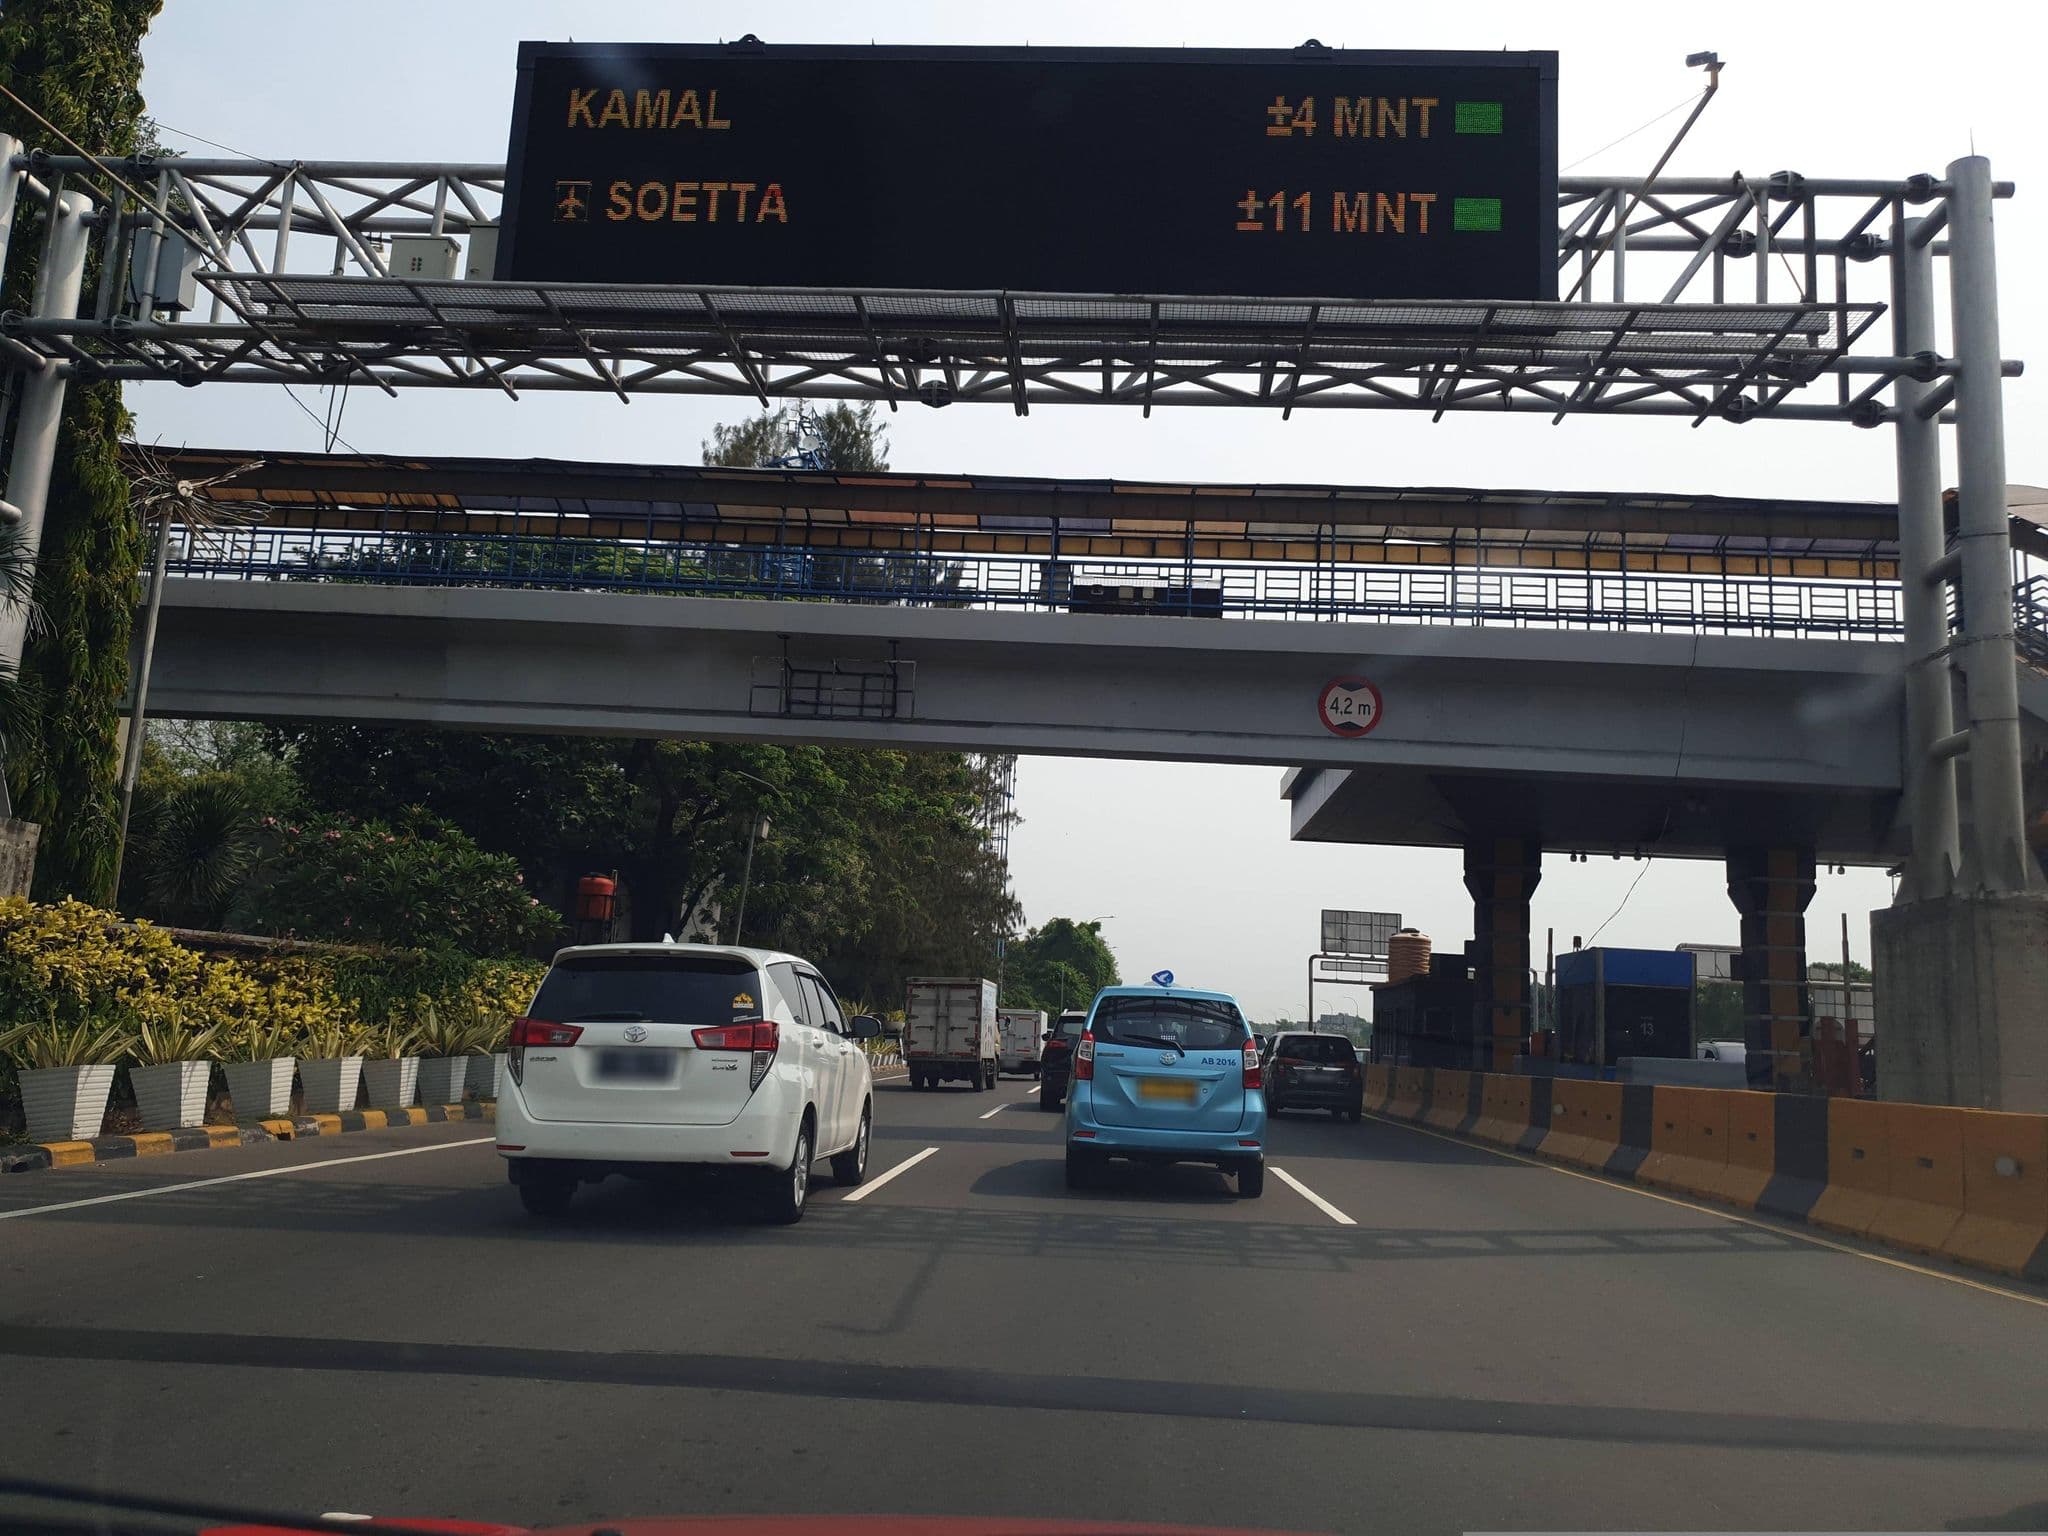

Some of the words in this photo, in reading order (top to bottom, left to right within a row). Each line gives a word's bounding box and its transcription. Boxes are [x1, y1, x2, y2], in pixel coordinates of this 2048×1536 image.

[567, 88, 732, 130] KAMAL
[1333, 96, 1440, 138] MNT
[605, 181, 789, 223] SOETTA
[1333, 191, 1438, 233] MNT
[1358, 703, 1371, 716] m
[1640, 1022, 1654, 1036] 13
[1201, 1057, 1214, 1065] AB
[1216, 1058, 1237, 1066] 2016
